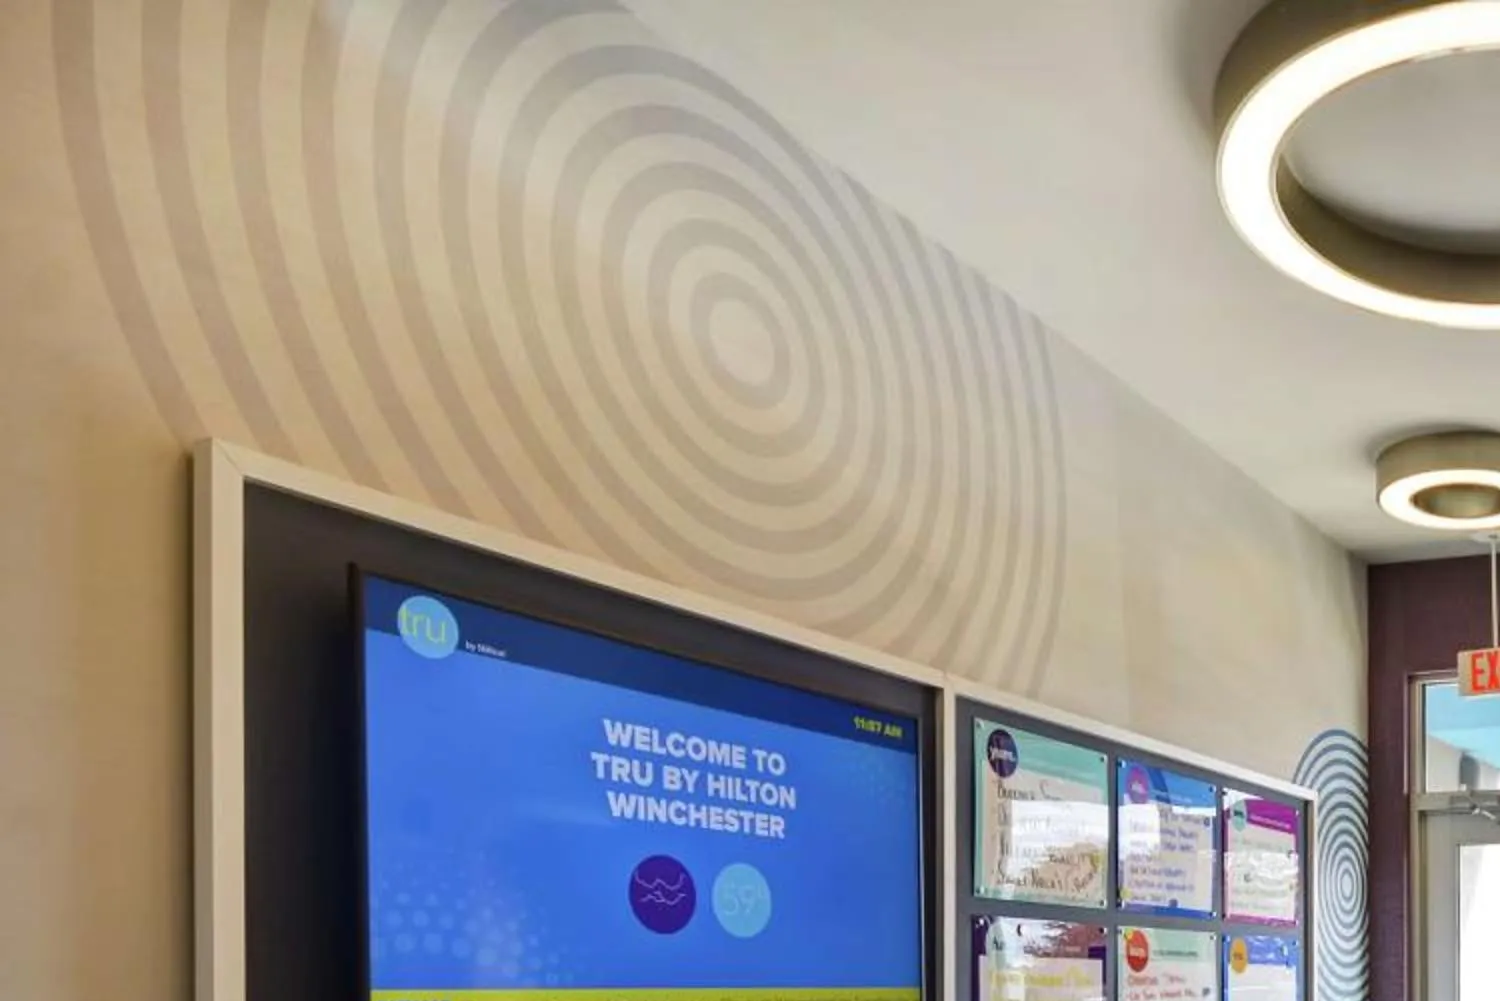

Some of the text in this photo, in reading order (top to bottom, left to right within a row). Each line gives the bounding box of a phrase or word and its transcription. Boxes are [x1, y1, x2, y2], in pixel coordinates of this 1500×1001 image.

[603, 718, 786, 776] WELCOME TO
[590, 751, 797, 809] TRU BY HILTON
[606, 790, 786, 839] WINCHESTER
